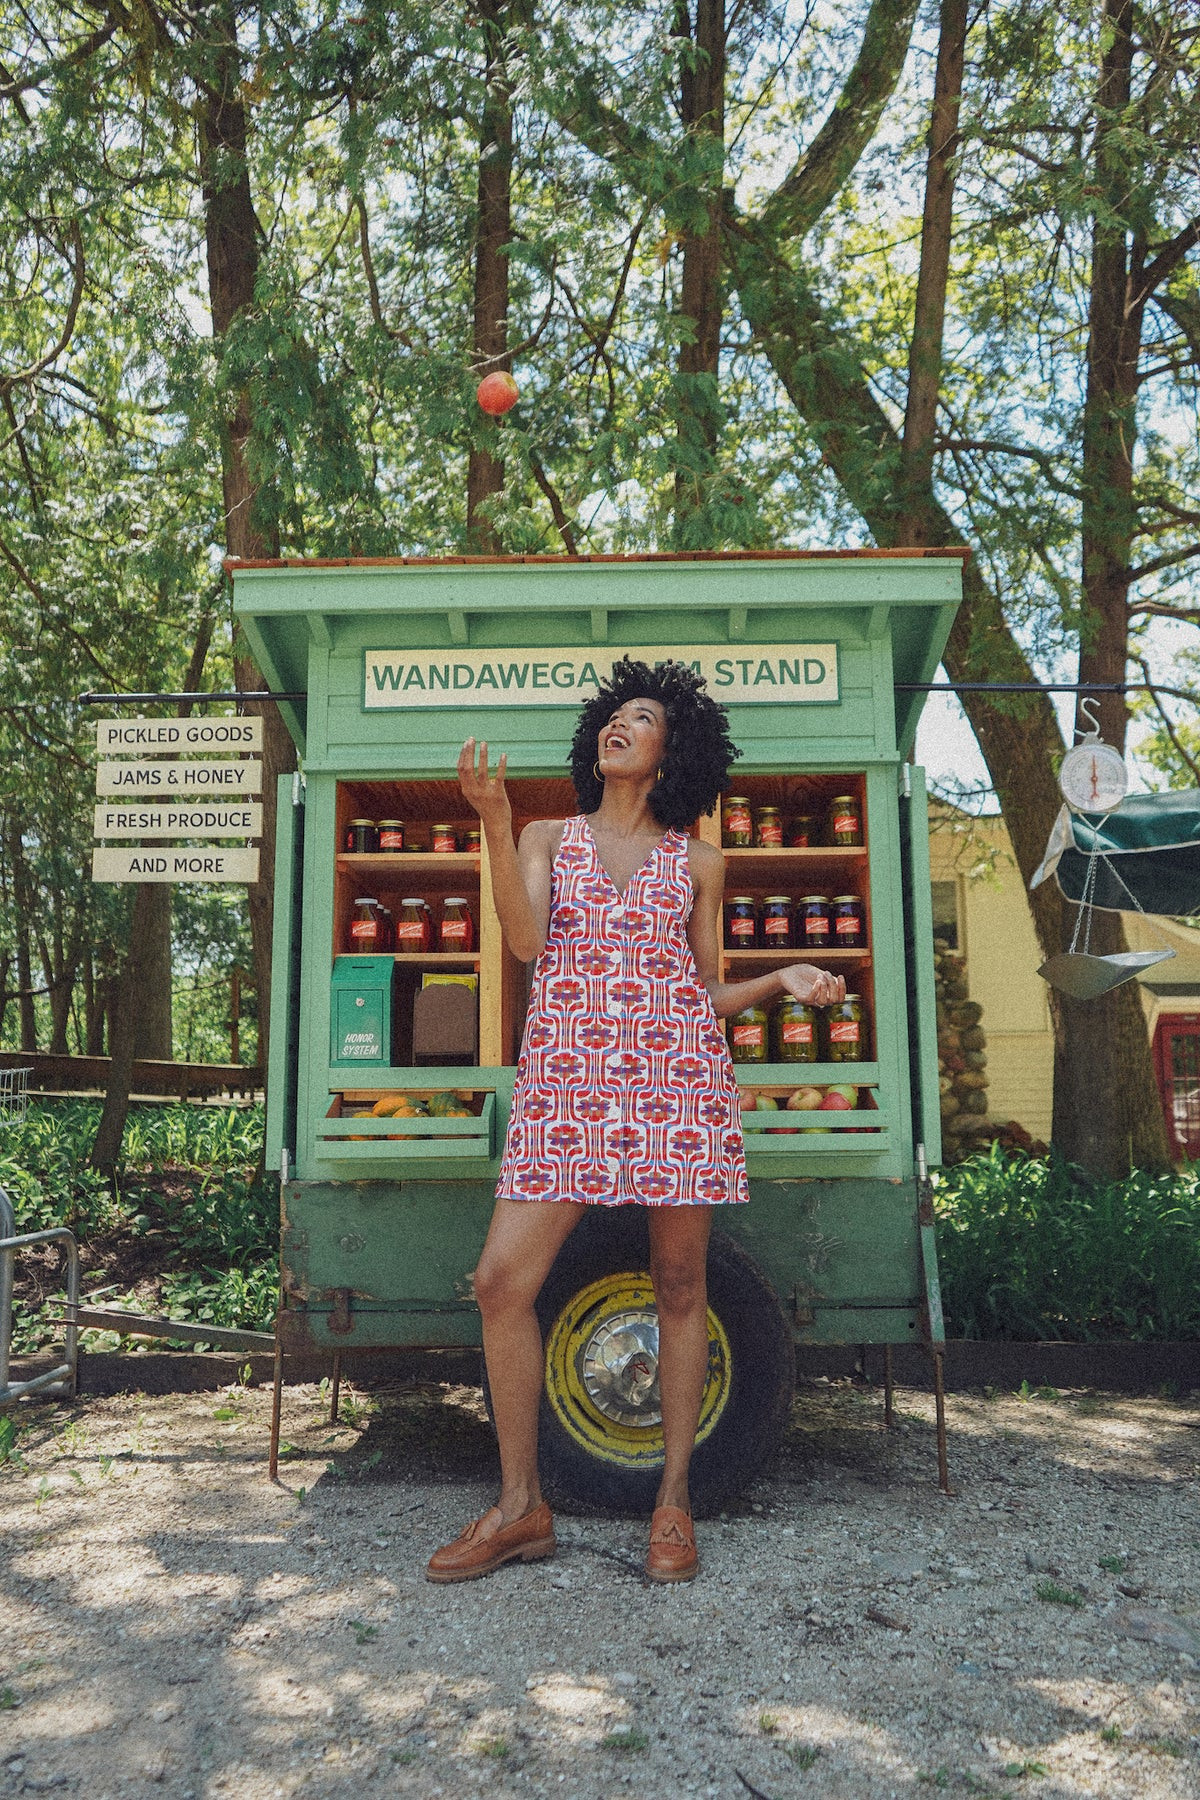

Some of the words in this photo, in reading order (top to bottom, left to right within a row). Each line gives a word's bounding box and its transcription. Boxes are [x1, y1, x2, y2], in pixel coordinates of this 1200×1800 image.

[372, 662, 600, 691] WANDAWEGA
[714, 658, 826, 686] STAND
[108, 728, 180, 744] PICKLED
[186, 726, 253, 742] GOODS
[112, 770, 161, 785] JAMS
[167, 769, 179, 784] &
[184, 769, 245, 784] HONEY
[106, 813, 161, 828] FRESH
[168, 812, 252, 827] PRODUCE
[128, 858, 167, 873] AND
[174, 858, 224, 873] MORE
[344, 1033, 374, 1043] HONOR
[341, 1045, 379, 1056] SYSTEM
